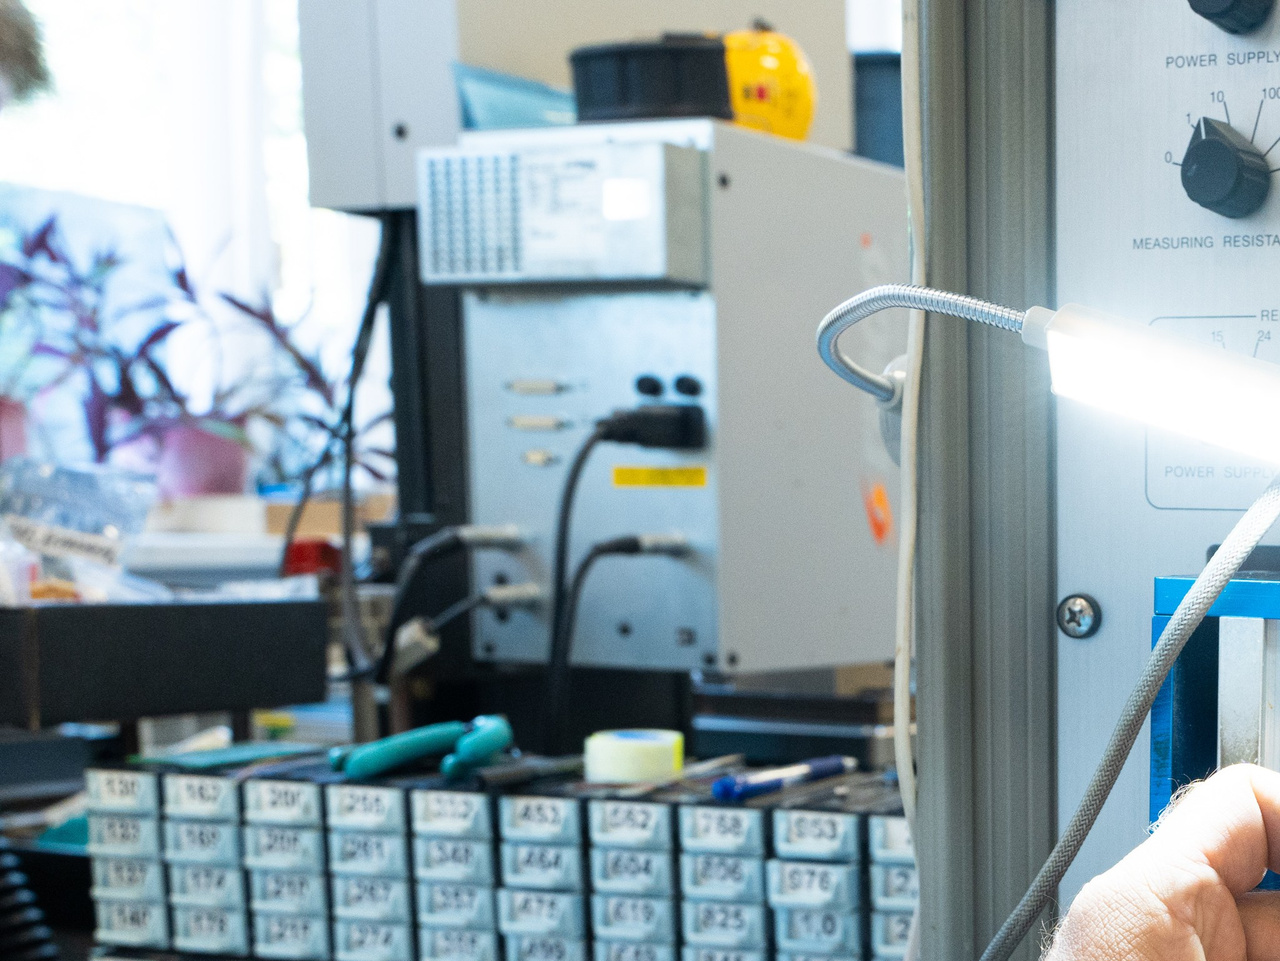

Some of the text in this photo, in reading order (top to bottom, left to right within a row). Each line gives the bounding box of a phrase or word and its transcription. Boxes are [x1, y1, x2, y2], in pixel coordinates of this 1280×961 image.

[1166, 54, 1218, 68] POWER
[1210, 91, 1224, 103] 10
[1132, 236, 1214, 250] MEASURING
[1211, 331, 1223, 342] 15
[1257, 330, 1271, 342] 24
[1164, 466, 1215, 478] POWER
[701, 906, 745, 932] 825
